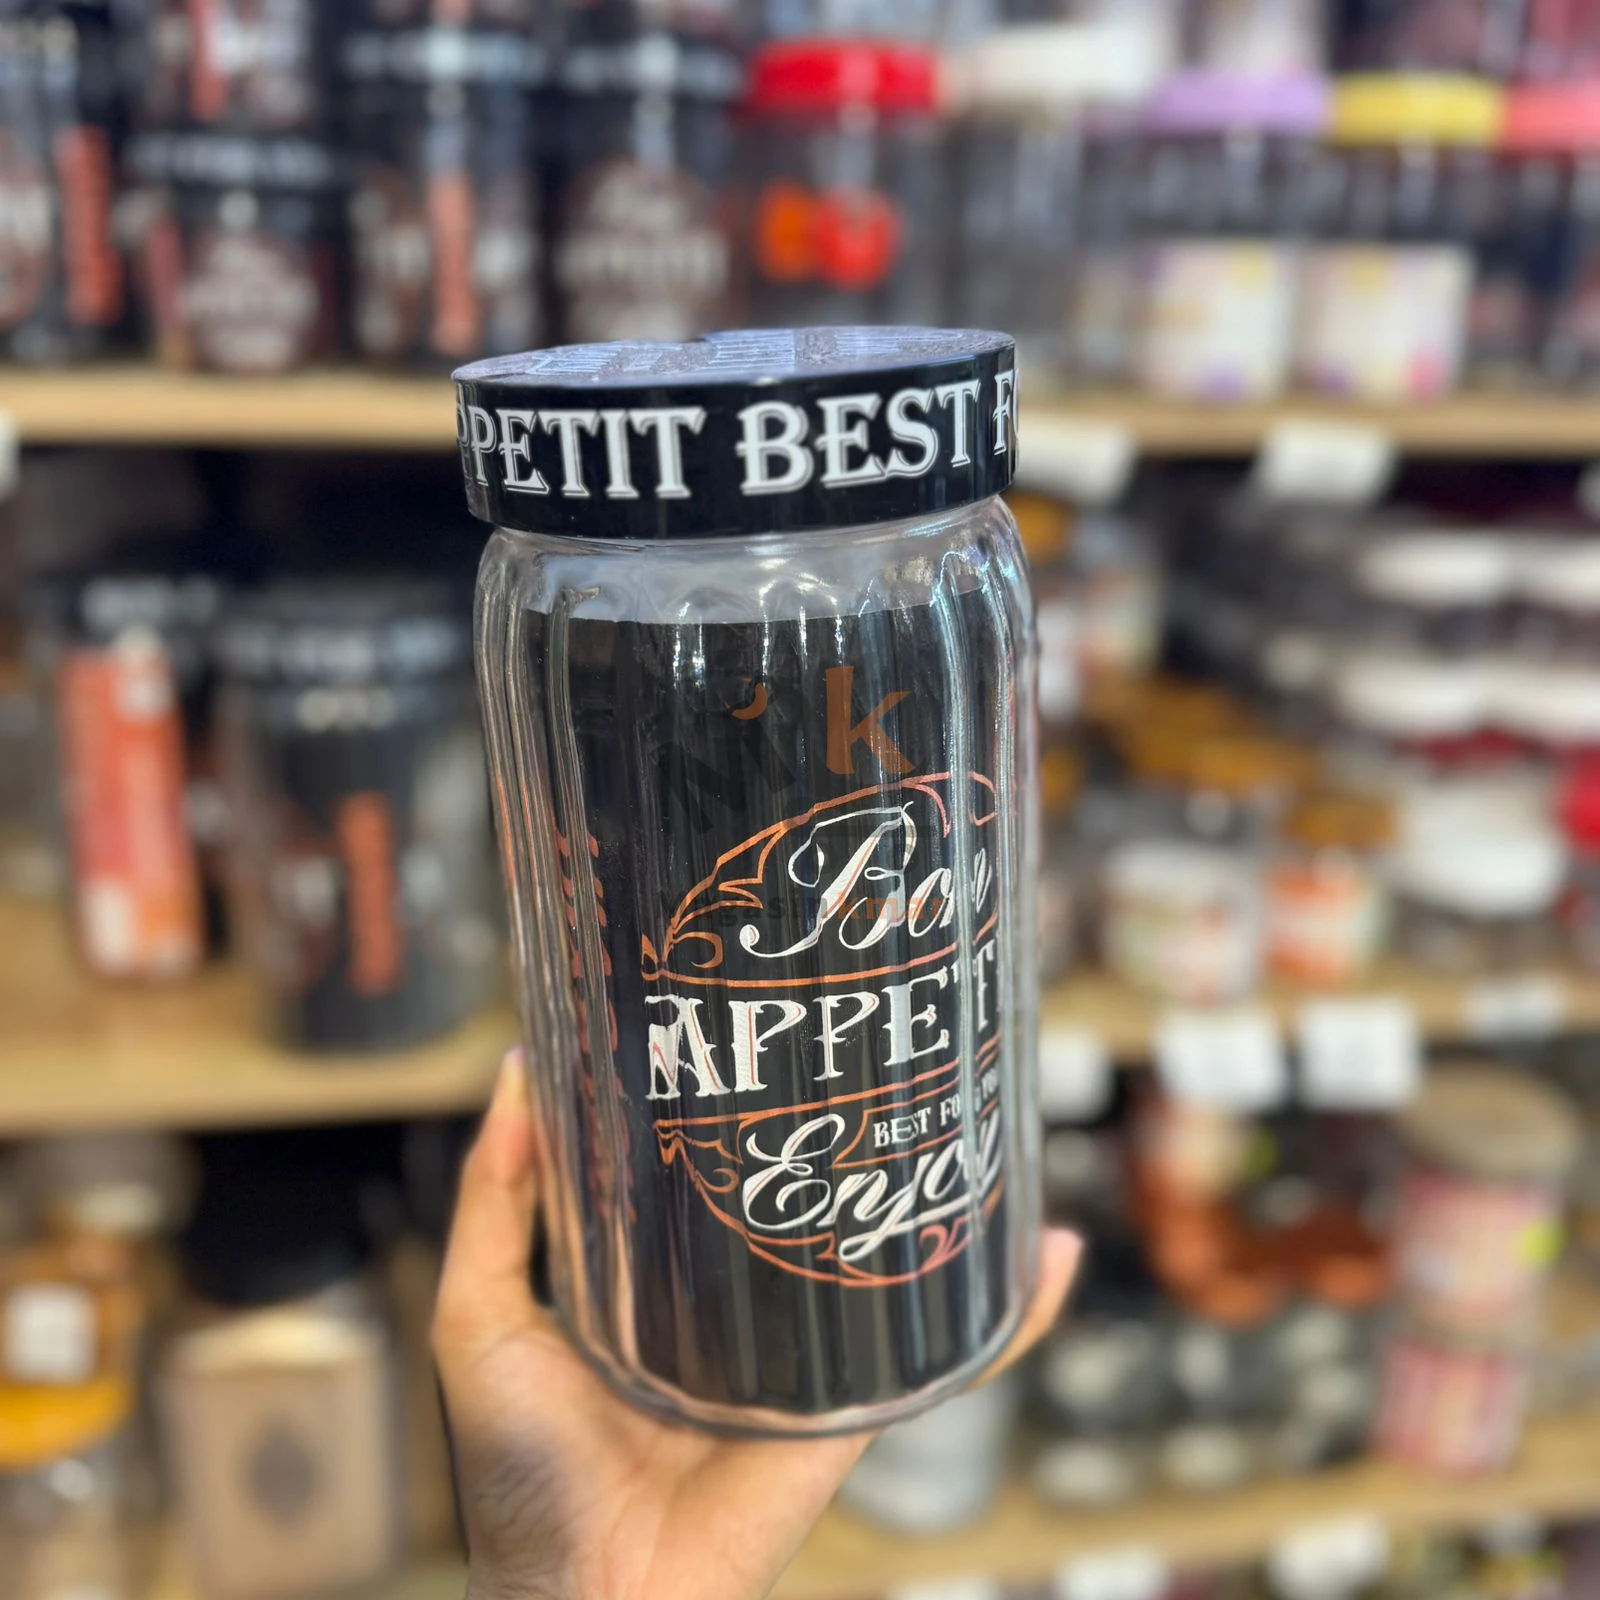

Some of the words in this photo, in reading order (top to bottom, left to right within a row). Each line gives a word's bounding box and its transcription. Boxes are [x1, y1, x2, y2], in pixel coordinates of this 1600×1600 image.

[736, 380, 981, 497] BEST
[873, 1107, 932, 1148] BEST
[742, 1112, 1003, 1262] Enjoy
